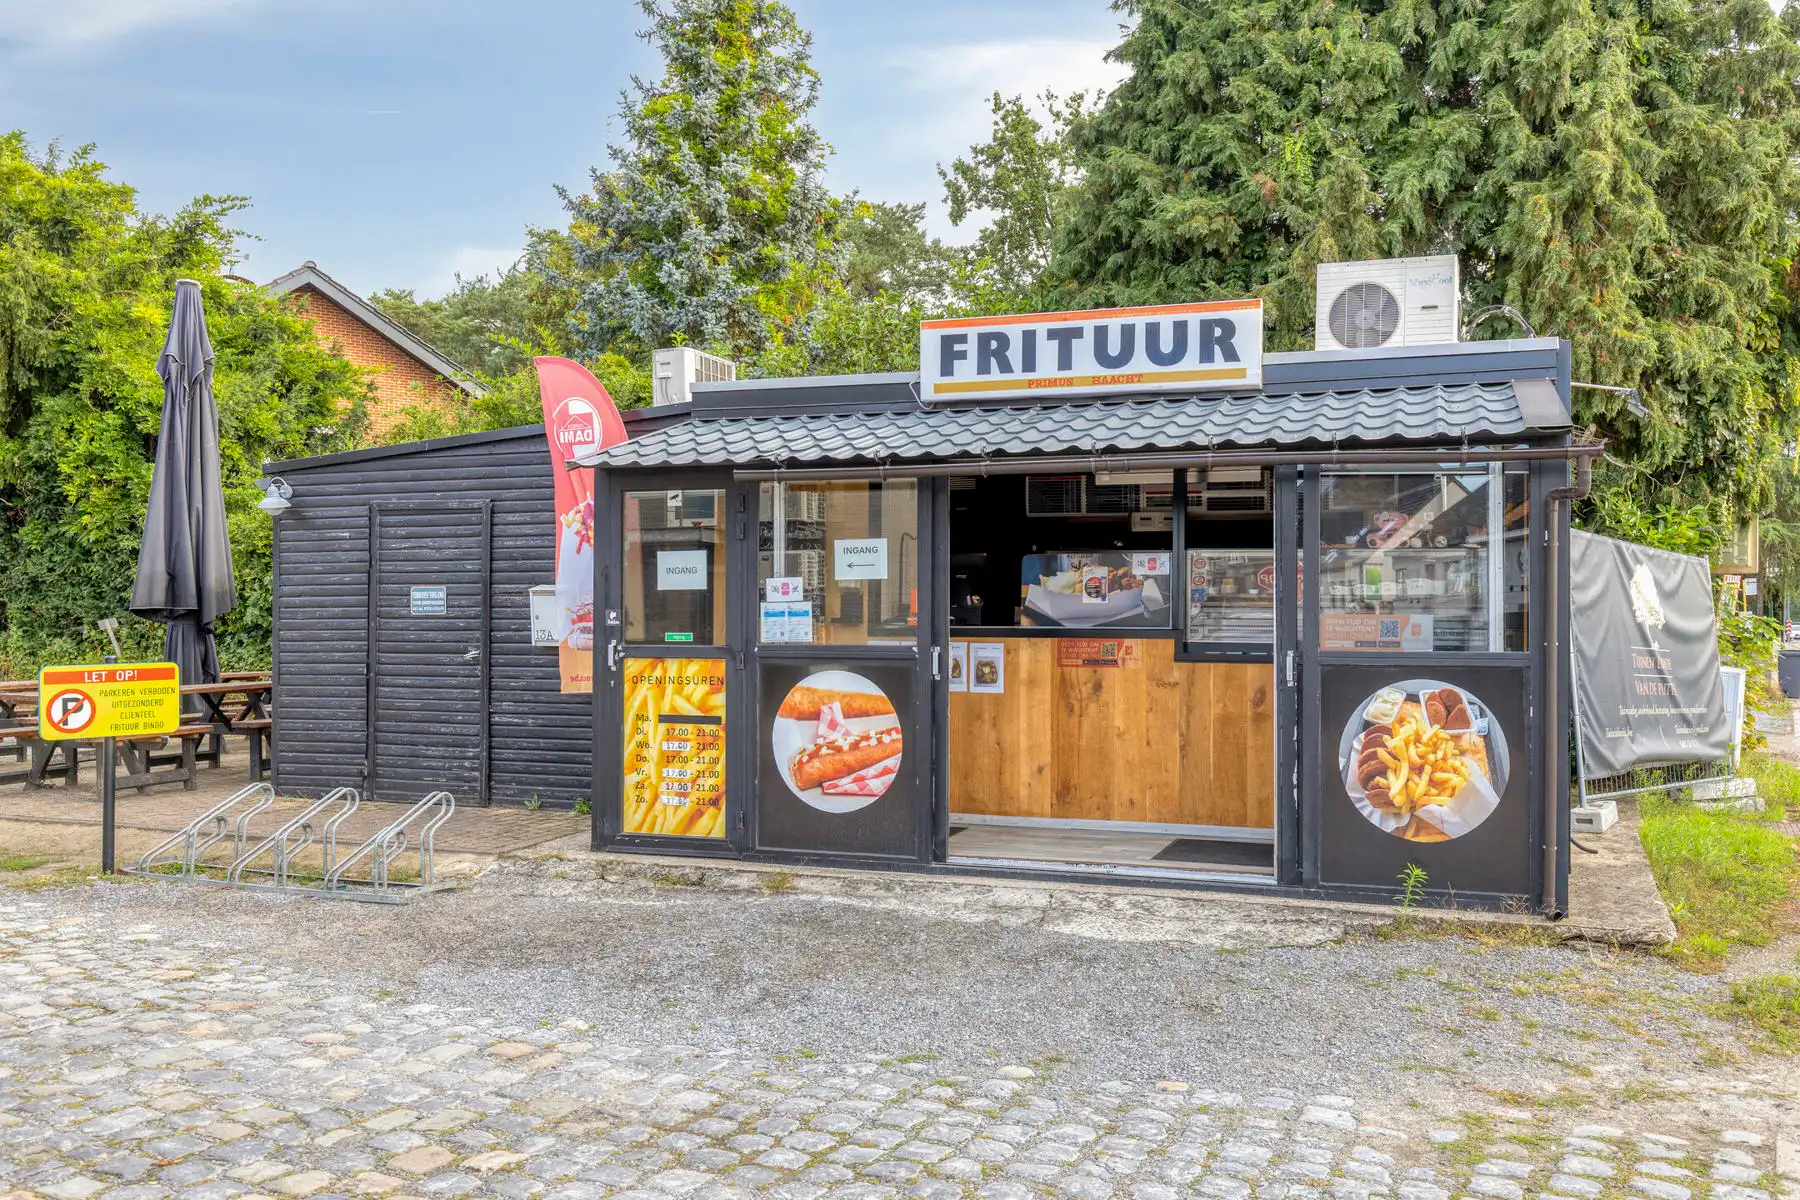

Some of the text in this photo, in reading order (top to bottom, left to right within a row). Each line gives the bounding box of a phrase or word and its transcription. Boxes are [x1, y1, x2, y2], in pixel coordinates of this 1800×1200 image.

[939, 317, 1241, 377] FRITUUR
[1028, 374, 1144, 388] PRIMUS HAACHT
[843, 546, 878, 555] INGANG
[665, 566, 698, 575] INGANG
[535, 629, 555, 640] 13A
[84, 670, 138, 682] LET OP!
[631, 675, 725, 686] OPENINGSUREN
[99, 686, 176, 697] PARKEREN VERBODEN
[111, 698, 164, 708] UITGEZONDERD
[120, 710, 156, 720] CLIENTEEL
[635, 713, 652, 722] Ma.
[110, 721, 164, 731] FRITUUR BINGO
[635, 727, 647, 735] Di.
[665, 728, 689, 736] 17.00
[696, 728, 720, 737] 21.00
[635, 741, 652, 749] Wo.
[696, 742, 720, 751] 21.00
[635, 755, 650, 763] Do.
[665, 755, 689, 764] 17.00
[696, 756, 720, 765] 21.00
[635, 768, 648, 776] Vr.
[696, 770, 720, 779] 21.00
[635, 782, 648, 790] Za.
[696, 784, 720, 792] 21.00
[635, 795, 648, 803] Zo.
[696, 797, 720, 806] 21.00
